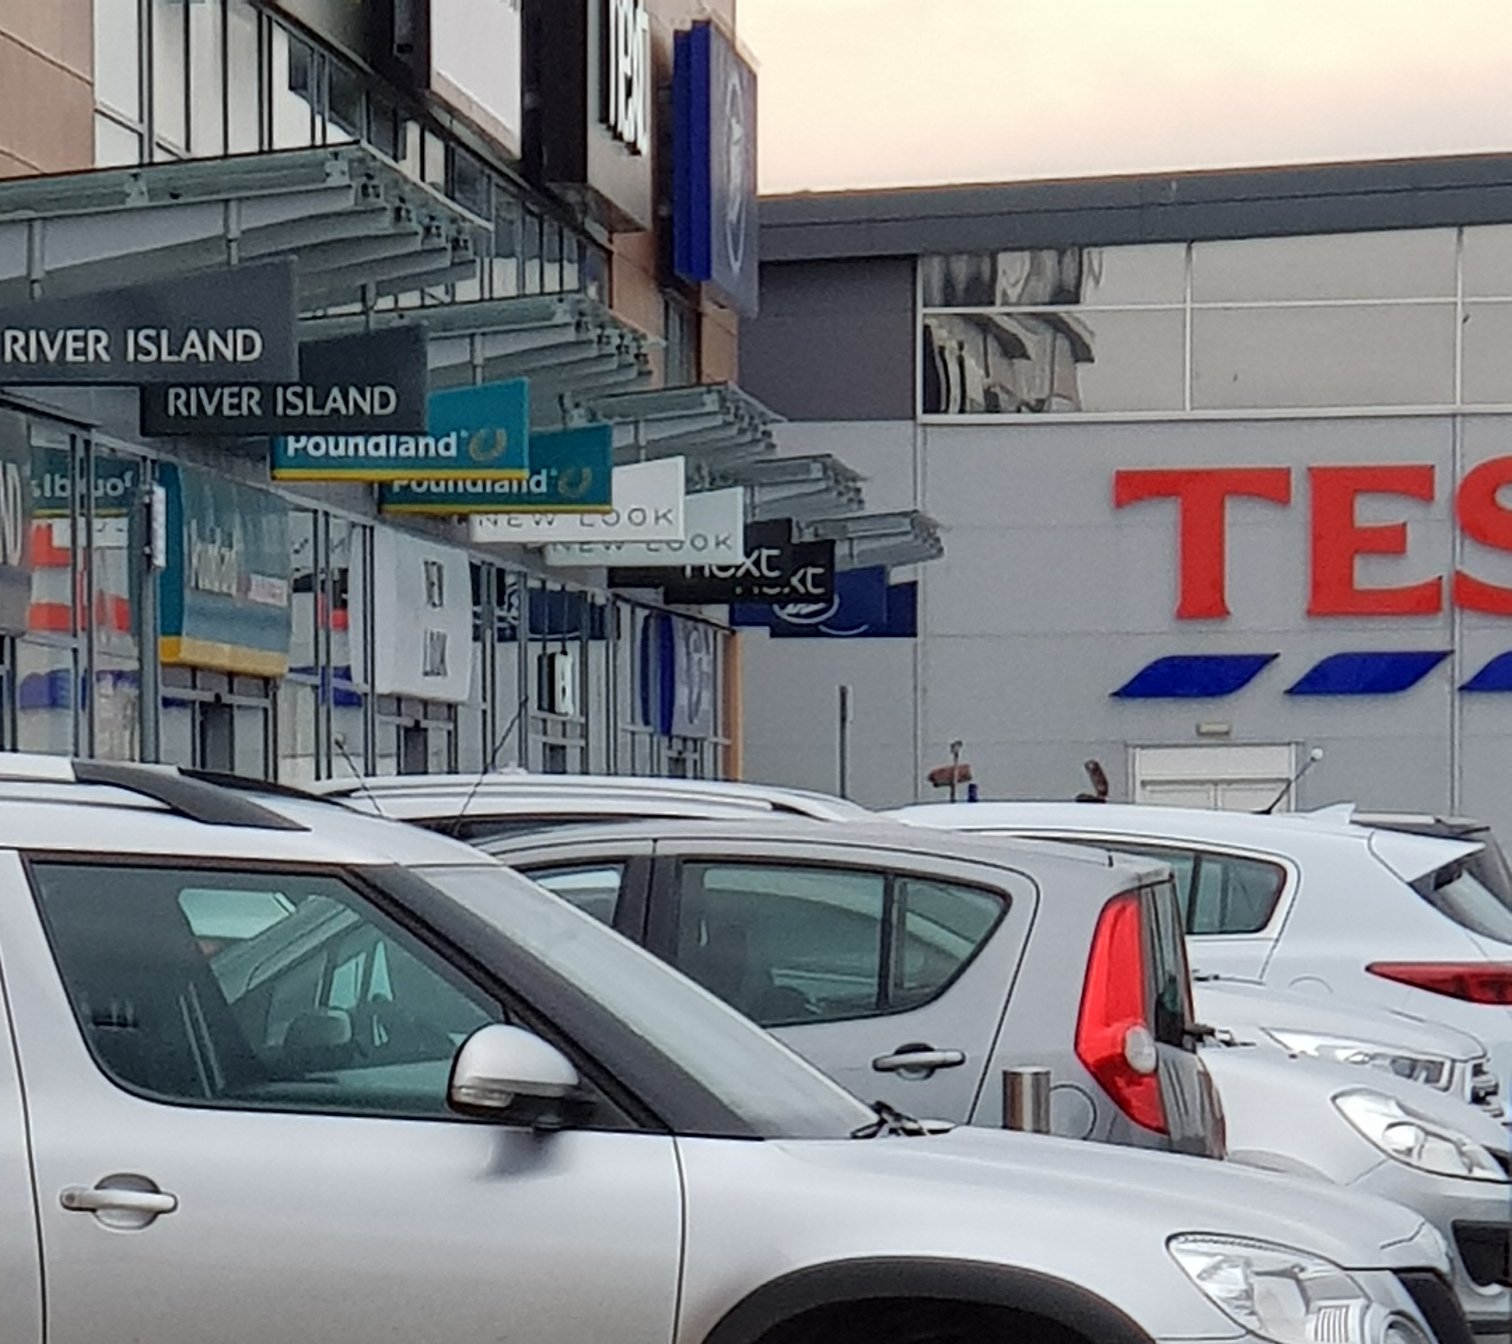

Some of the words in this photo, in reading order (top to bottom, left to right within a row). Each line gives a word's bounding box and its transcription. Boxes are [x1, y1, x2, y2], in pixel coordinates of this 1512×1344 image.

[2, 327, 111, 364] RIVER
[125, 328, 264, 364] ISLAND
[166, 386, 263, 418] RIVER
[275, 384, 398, 418] ISLAND
[286, 430, 459, 459] Poundland
[478, 512, 557, 528] NEW
[579, 507, 675, 528] LOOK
[734, 566, 826, 595] xt
